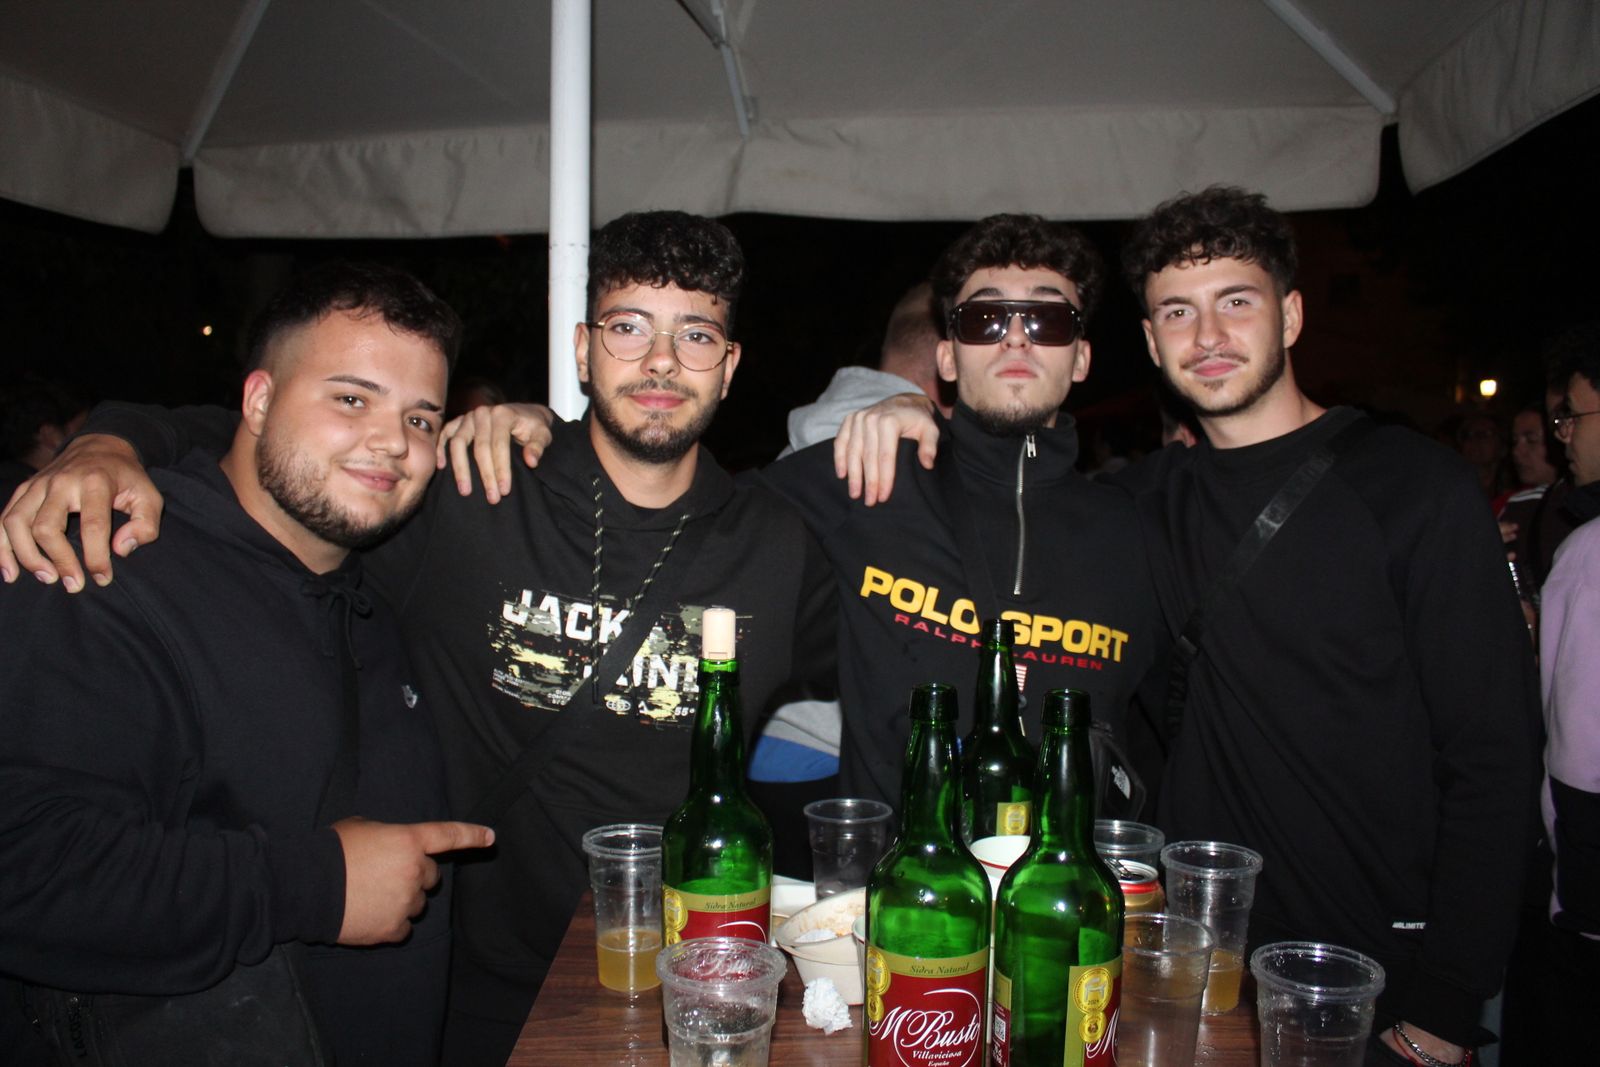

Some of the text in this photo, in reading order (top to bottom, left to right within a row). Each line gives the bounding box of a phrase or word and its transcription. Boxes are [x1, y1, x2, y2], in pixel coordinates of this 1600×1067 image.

[502, 588, 630, 644] JACK
[860, 565, 1129, 663] POLO SPORT
[1012, 650, 1104, 671] AUREN
[704, 897, 757, 910] Sidra Natural
[911, 961, 970, 975] Sidra Natural
